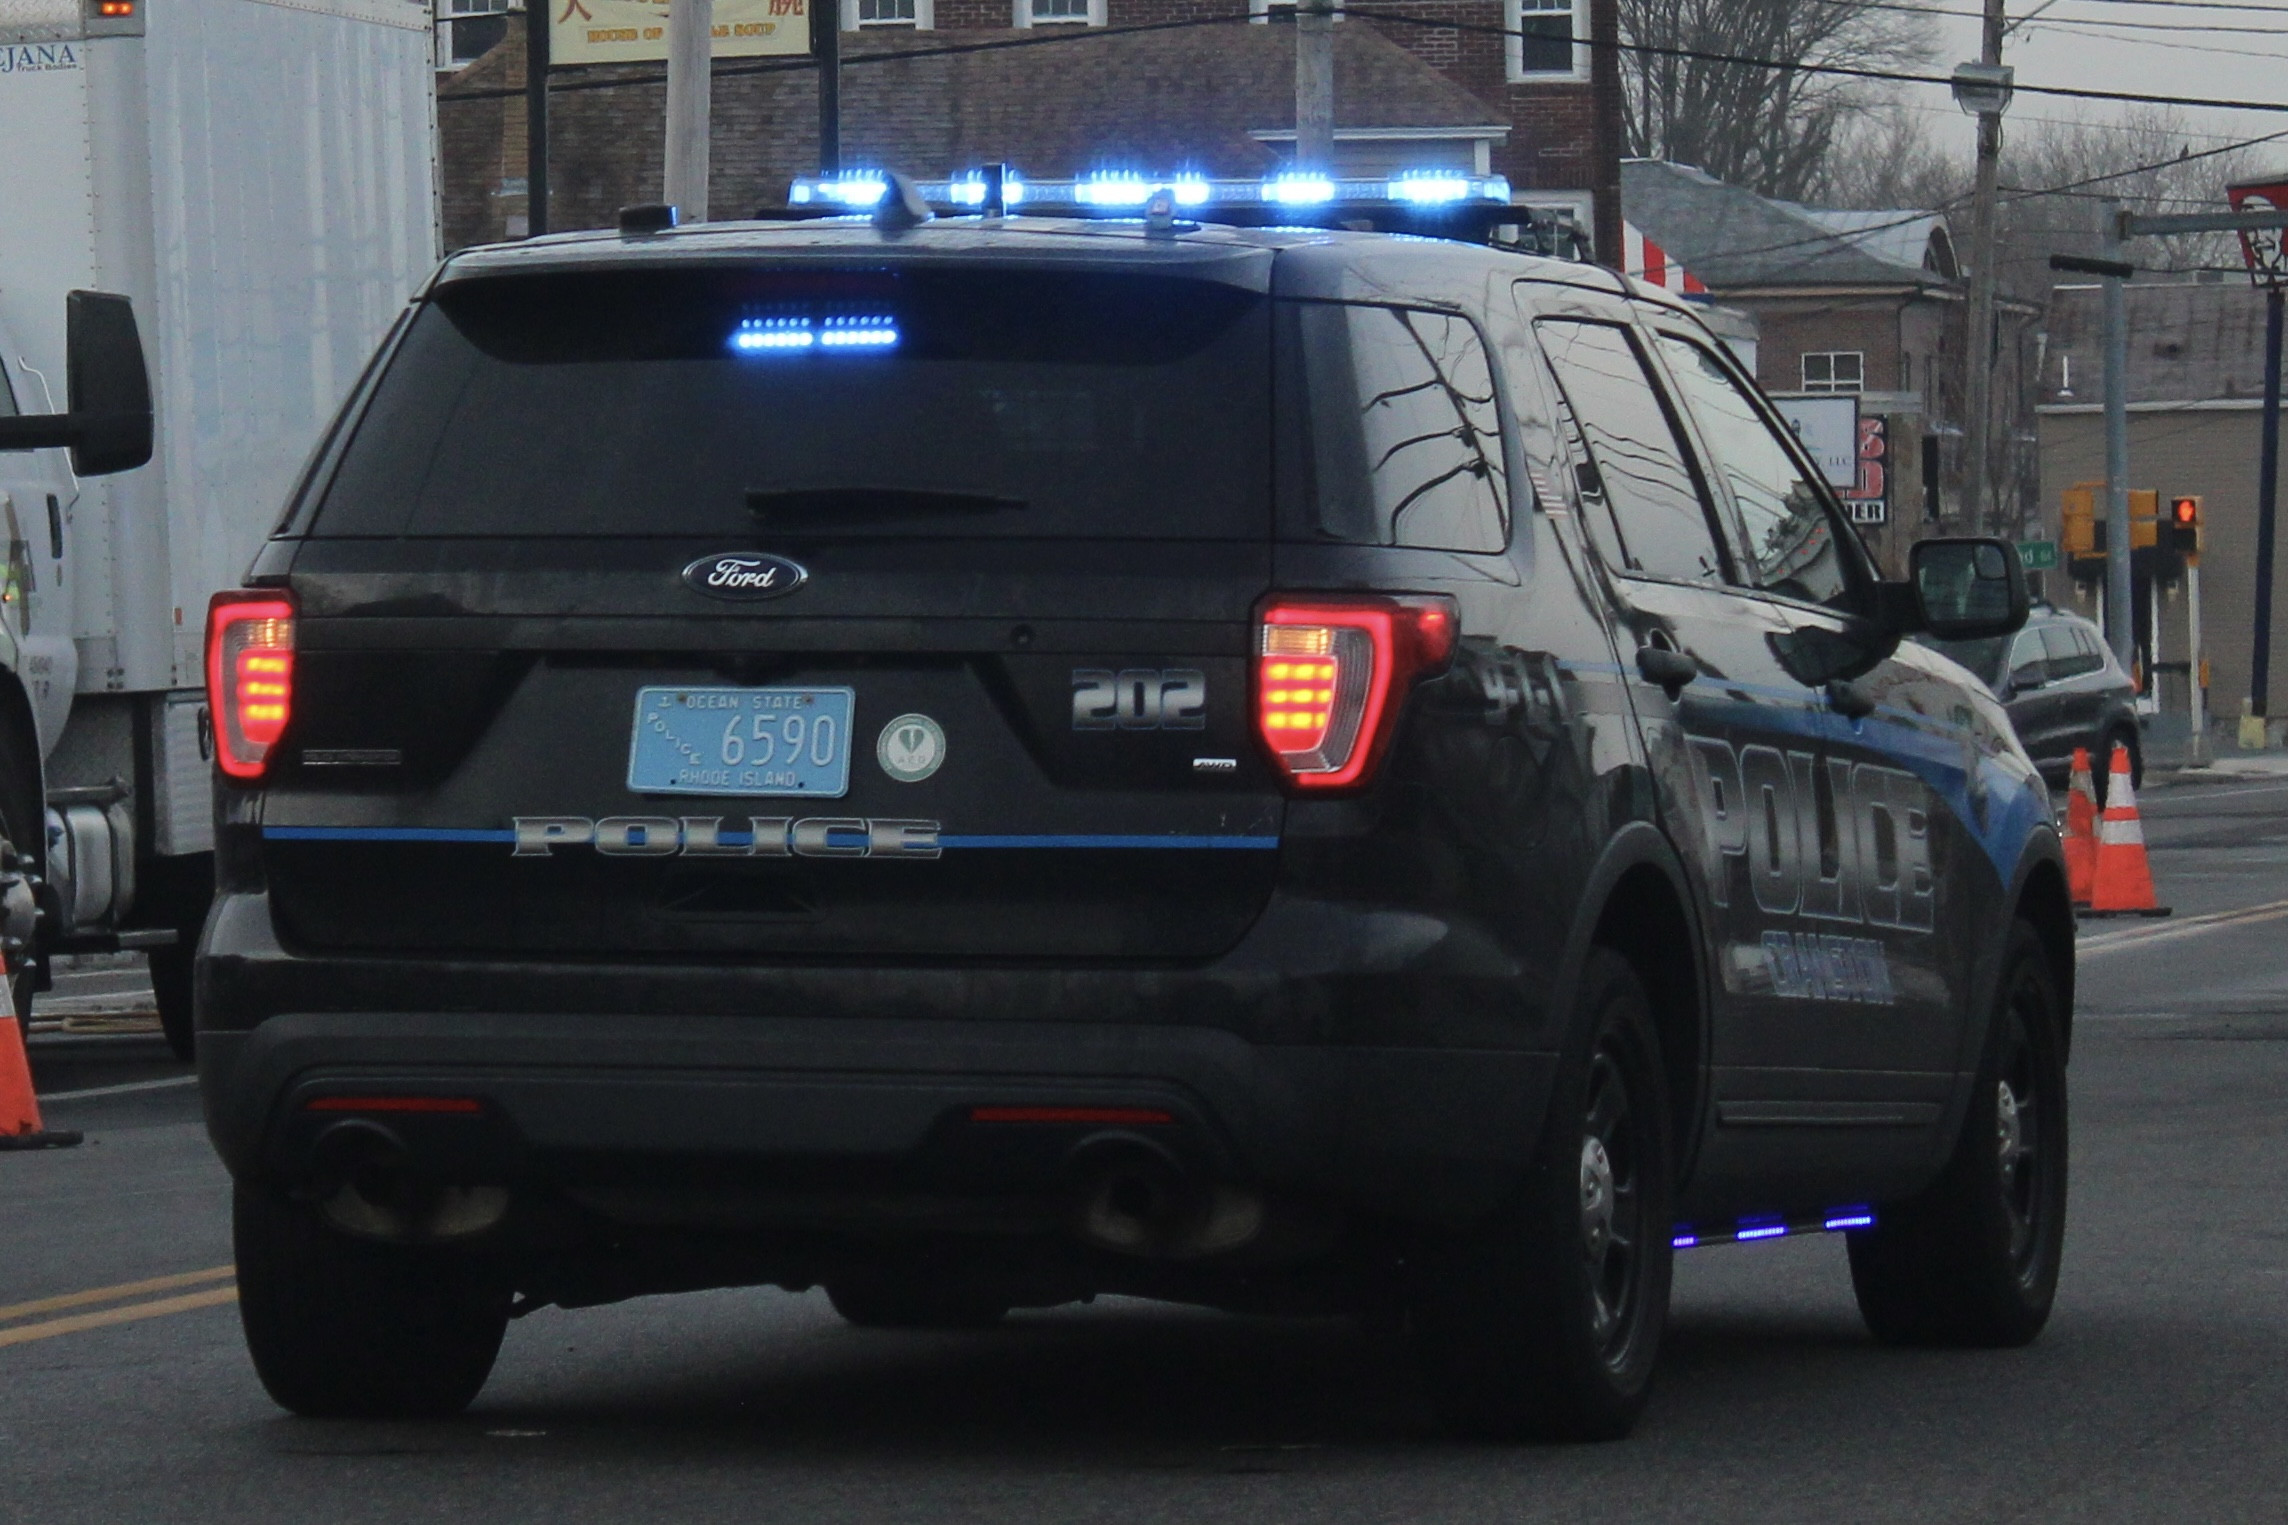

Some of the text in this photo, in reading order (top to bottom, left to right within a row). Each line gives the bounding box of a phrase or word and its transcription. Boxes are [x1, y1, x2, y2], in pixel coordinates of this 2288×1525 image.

[707, 558, 777, 588] Ford
[685, 695, 803, 710] OCEAN STATE
[1072, 669, 1206, 730] 202
[647, 711, 702, 766] POLICE
[722, 714, 837, 767] 6590
[679, 768, 796, 787] RHODE ISLAND
[512, 815, 943, 859] POLICE
[1683, 733, 1934, 933] POLICE
